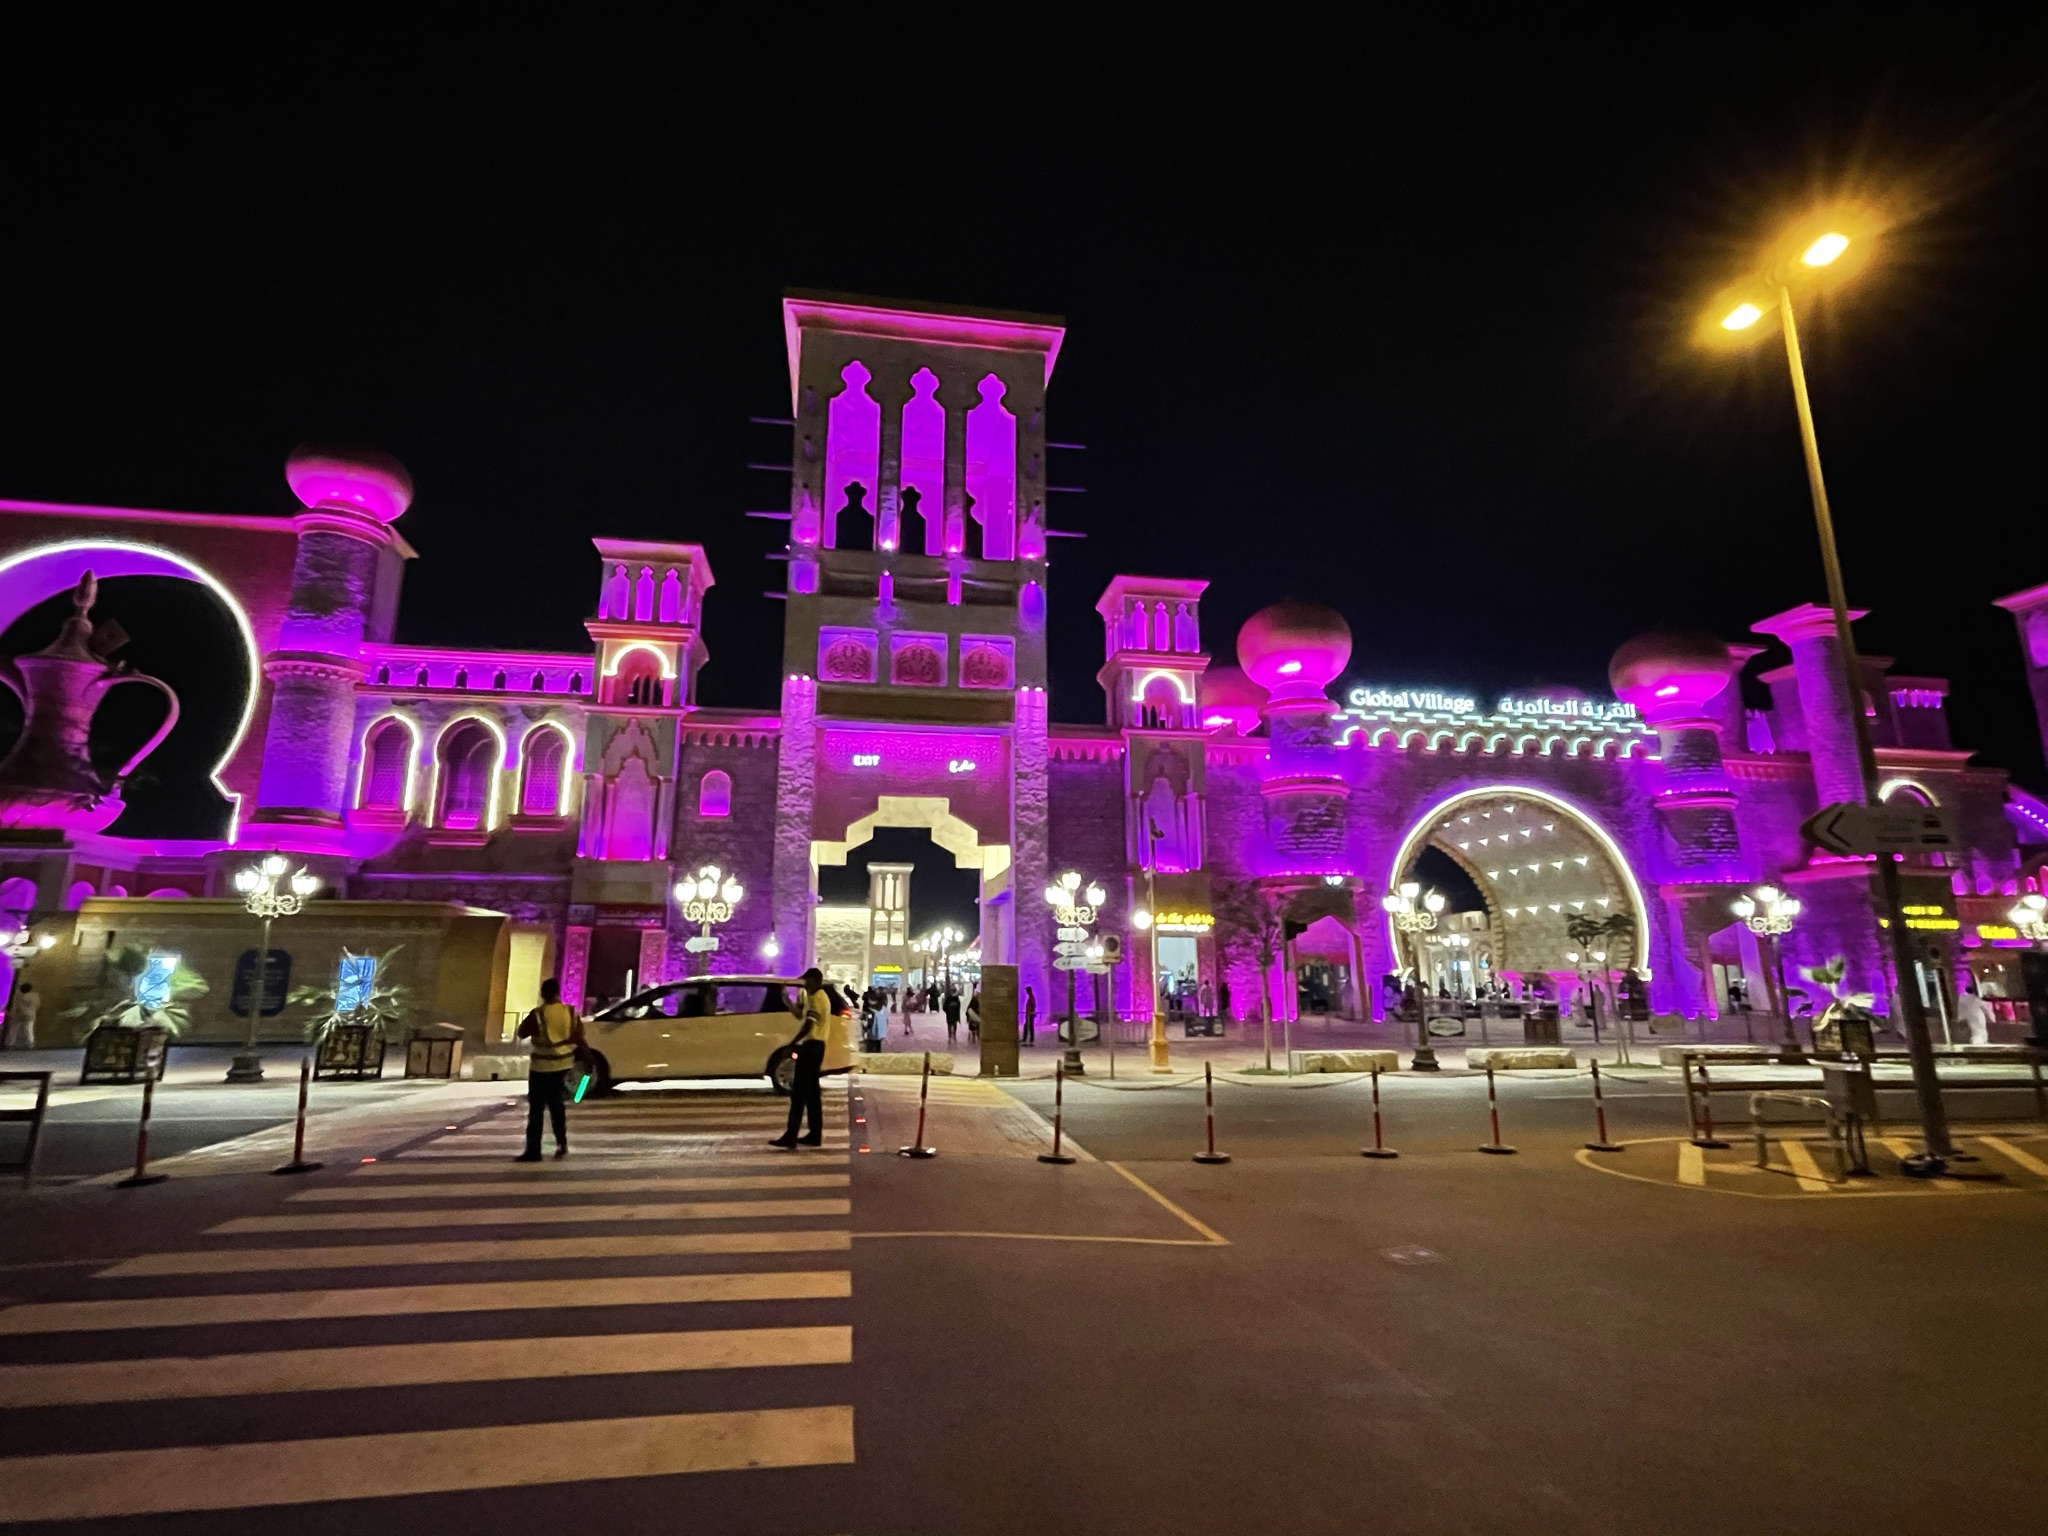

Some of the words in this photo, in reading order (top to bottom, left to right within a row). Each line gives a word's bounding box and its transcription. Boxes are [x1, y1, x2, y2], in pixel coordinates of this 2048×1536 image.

[1350, 688, 1410, 709] Global
[1409, 691, 1475, 715] Village
[1500, 698, 1578, 716] العالمية
[1581, 701, 1637, 721] القرية
[853, 755, 880, 766] EXIT
